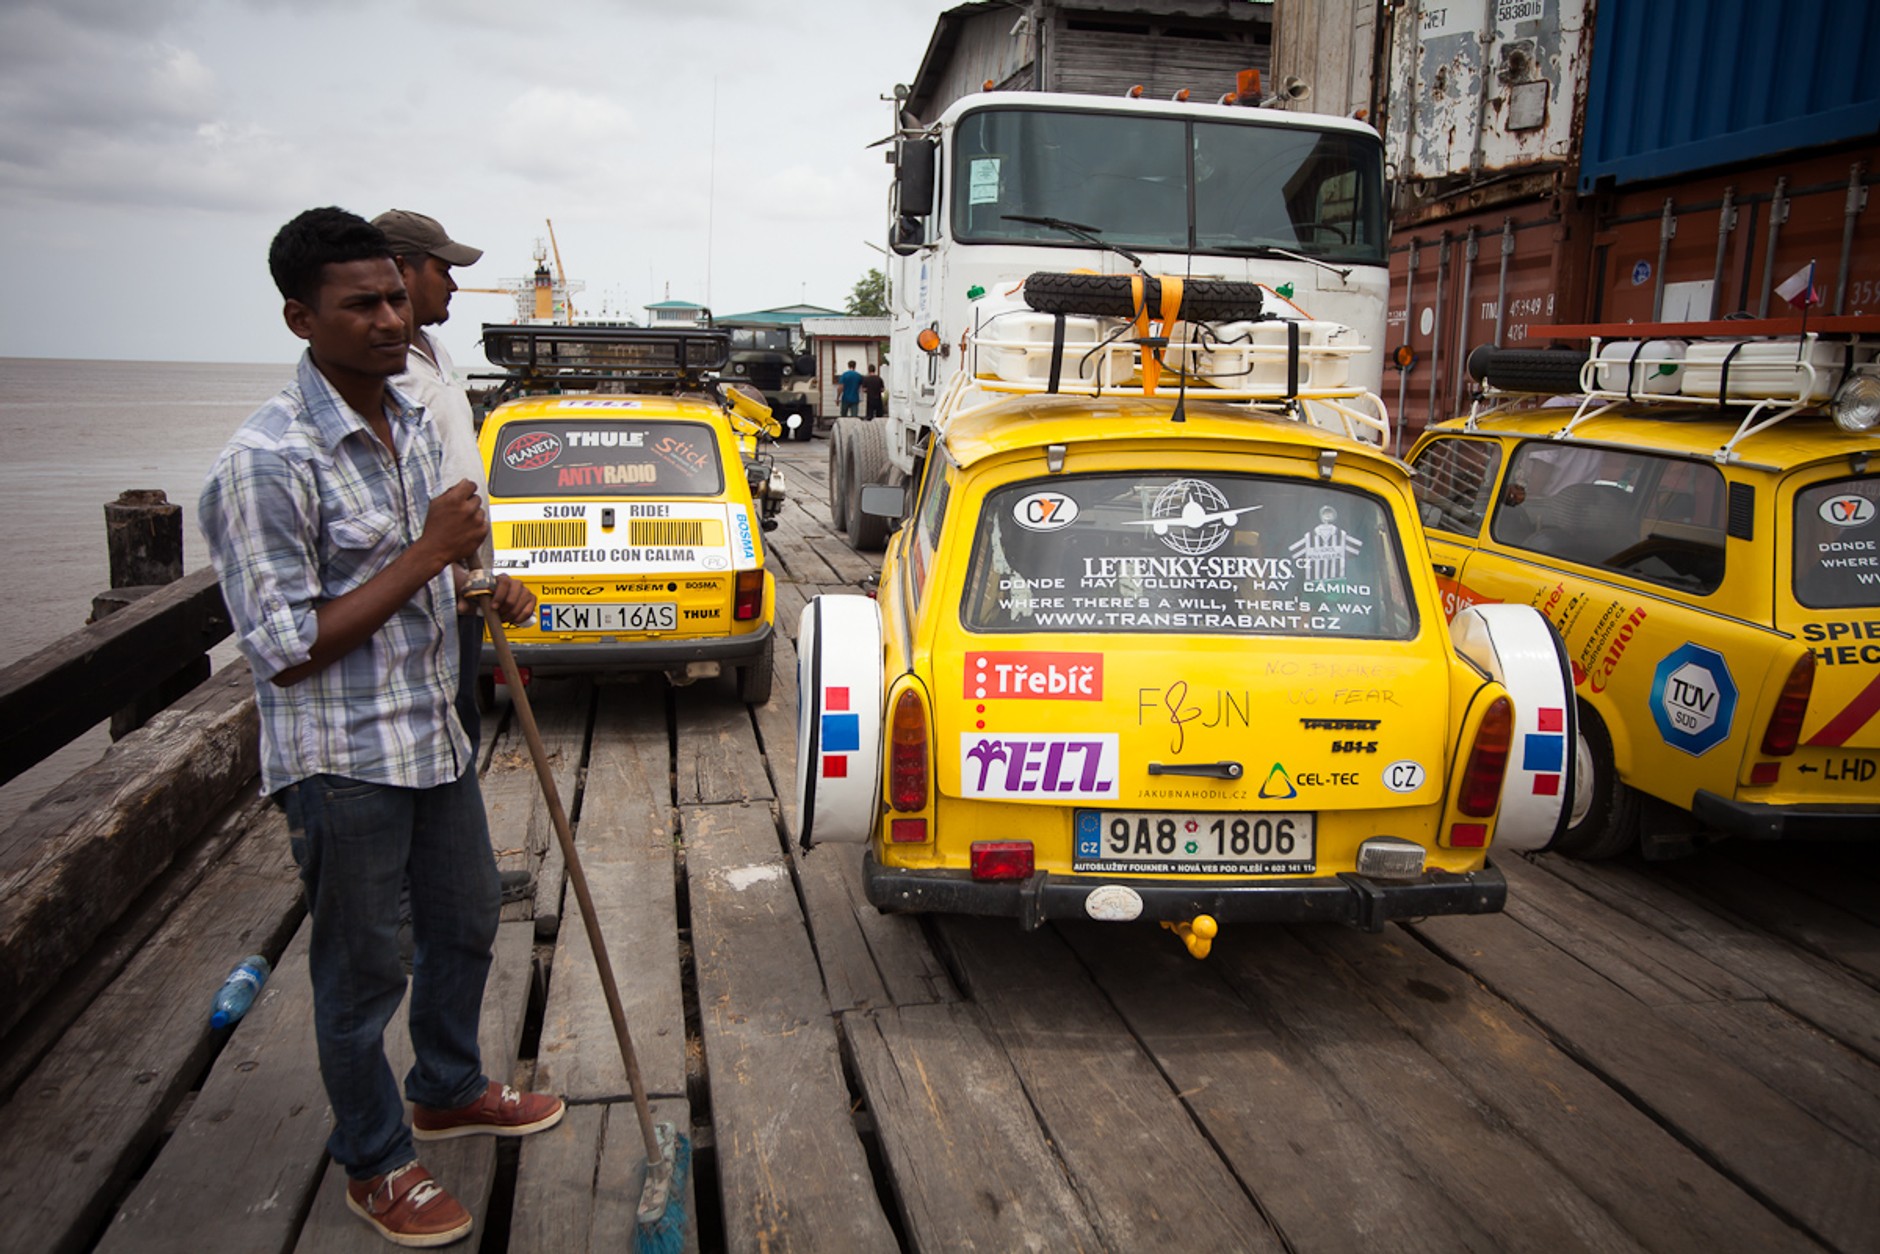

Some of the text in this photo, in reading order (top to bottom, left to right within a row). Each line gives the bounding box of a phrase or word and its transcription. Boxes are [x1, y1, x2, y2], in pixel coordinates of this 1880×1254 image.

[566, 431, 644, 447] THULE
[507, 438, 559, 465] PLANETA
[655, 437, 708, 468] Stick
[558, 464, 656, 487] ANTYRADIO
[543, 505, 669, 518] SLOW RIDE!
[1027, 498, 1065, 523] CZ
[1831, 499, 1867, 522] CZ
[736, 513, 754, 559] BOSMA
[1819, 541, 1876, 551] DONDE
[529, 548, 695, 564] TÓMATELO CON CALMA
[1821, 557, 1879, 568] WHERE
[685, 581, 718, 590] BOSMA
[1000, 578, 1371, 596] DONDE HAY VOLUNTAD, HAY CAMINO
[1857, 573, 1880, 584] W
[999, 593, 1373, 616] WHERE THERE'S A WILL, THERE'S A WAY
[618, 606, 673, 628] 16AS
[683, 609, 720, 619] THULE
[1034, 613, 1341, 630] WWW.TRANSTRABANT.CZ
[1591, 607, 1648, 694] Canon
[1265, 660, 1299, 677] NO
[995, 664, 1093, 695] Třebíč
[1333, 689, 1403, 707] FEAR
[1672, 678, 1716, 712] TÜV
[1675, 711, 1698, 729] SÜD
[1296, 772, 1359, 786] CEL-TEC
[1392, 766, 1417, 788] CZ
[1824, 759, 1877, 782] LHD
[1138, 789, 1247, 799] JAKUBNAHODIL.CZ
[1080, 818, 1295, 855] CZ 9A8 1806
[1178, 862, 1200, 872] NOVÁ
[1220, 864, 1237, 872] POD
